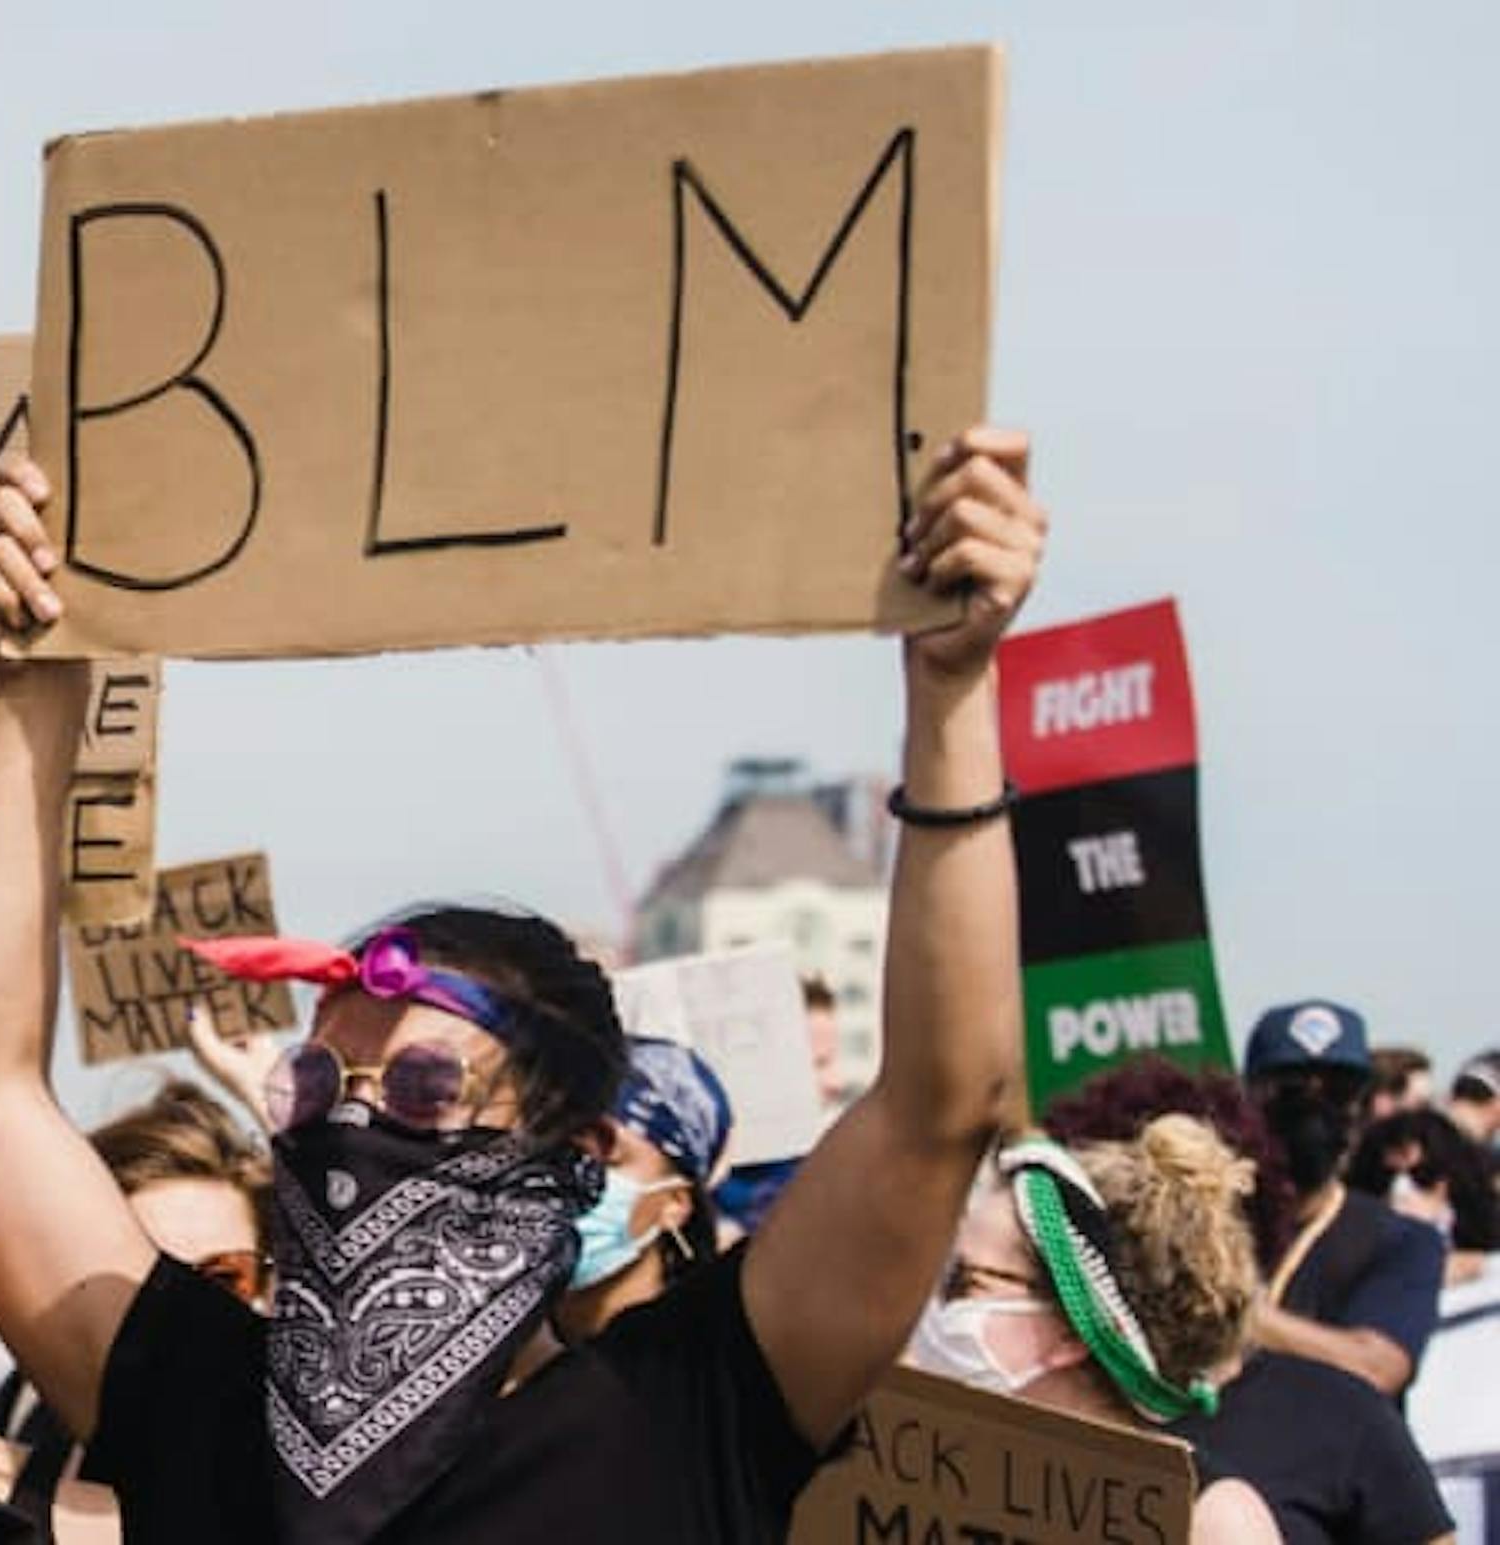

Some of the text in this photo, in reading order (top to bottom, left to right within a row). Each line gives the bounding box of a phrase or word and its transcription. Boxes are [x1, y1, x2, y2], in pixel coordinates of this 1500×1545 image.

[1031, 662, 1155, 739] FIGHT
[1067, 830, 1146, 893] THE
[97, 948, 220, 1003] LIVE
[84, 984, 278, 1063] MATER
[1003, 1450, 1165, 1545] LIVES
